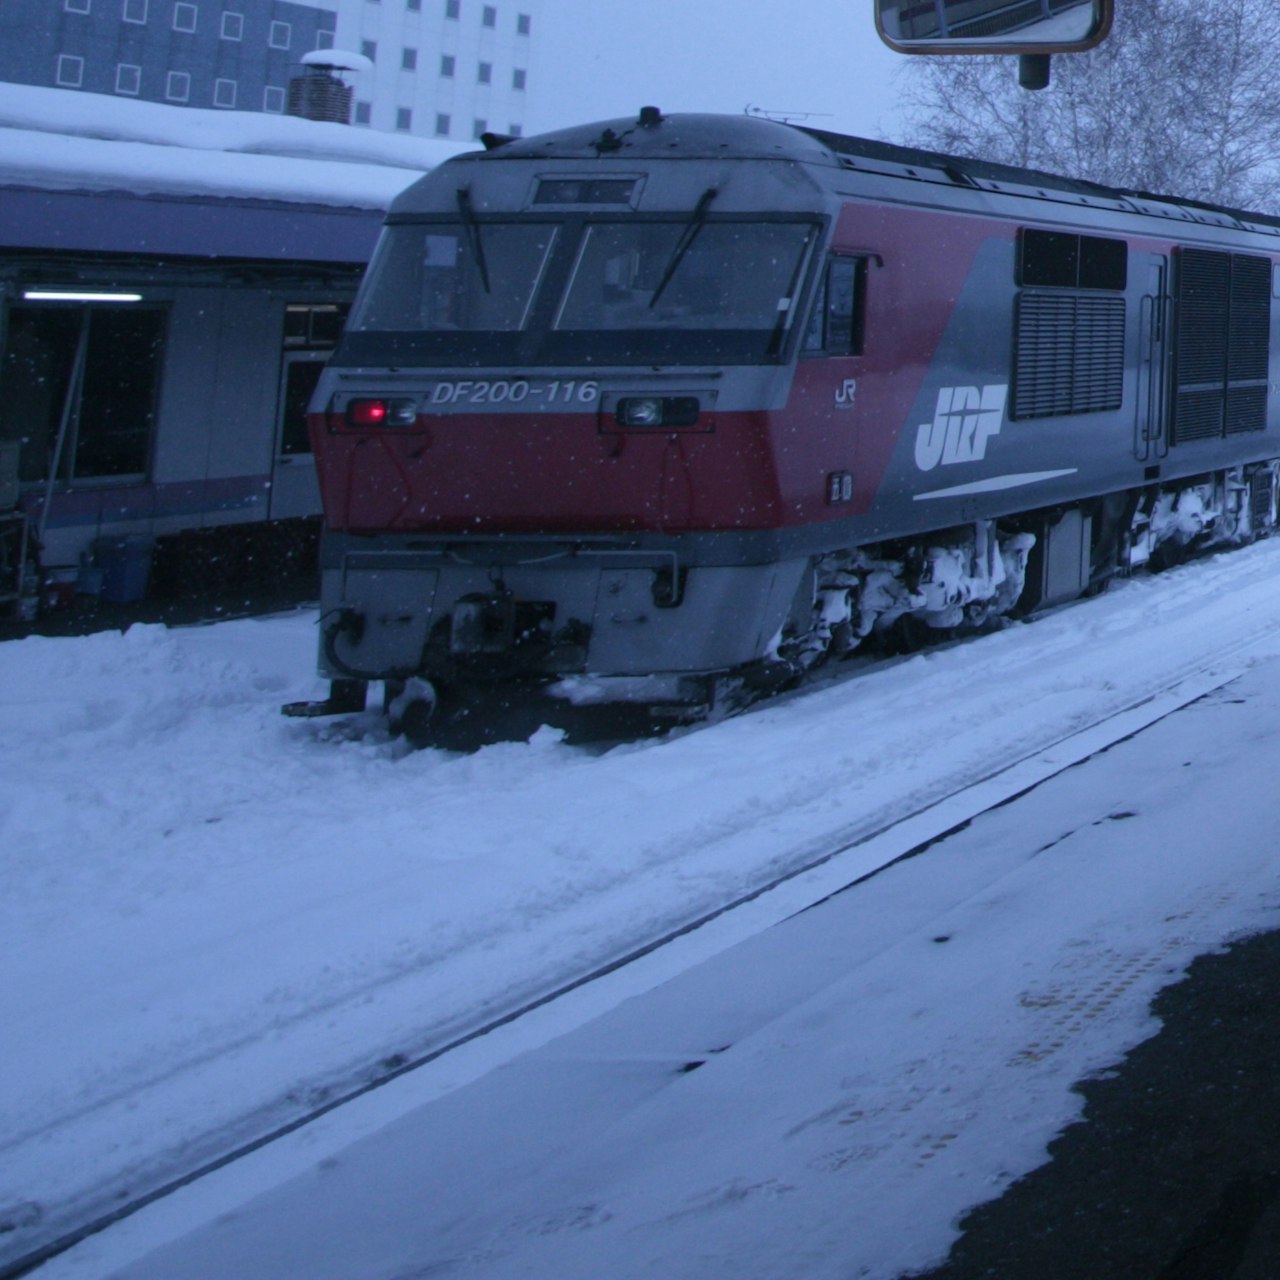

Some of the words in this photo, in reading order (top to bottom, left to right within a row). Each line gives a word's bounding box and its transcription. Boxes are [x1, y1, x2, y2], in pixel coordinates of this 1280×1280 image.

[431, 380, 599, 404] DF200-116
[835, 379, 857, 403] JR
[914, 384, 1008, 471] JRF
